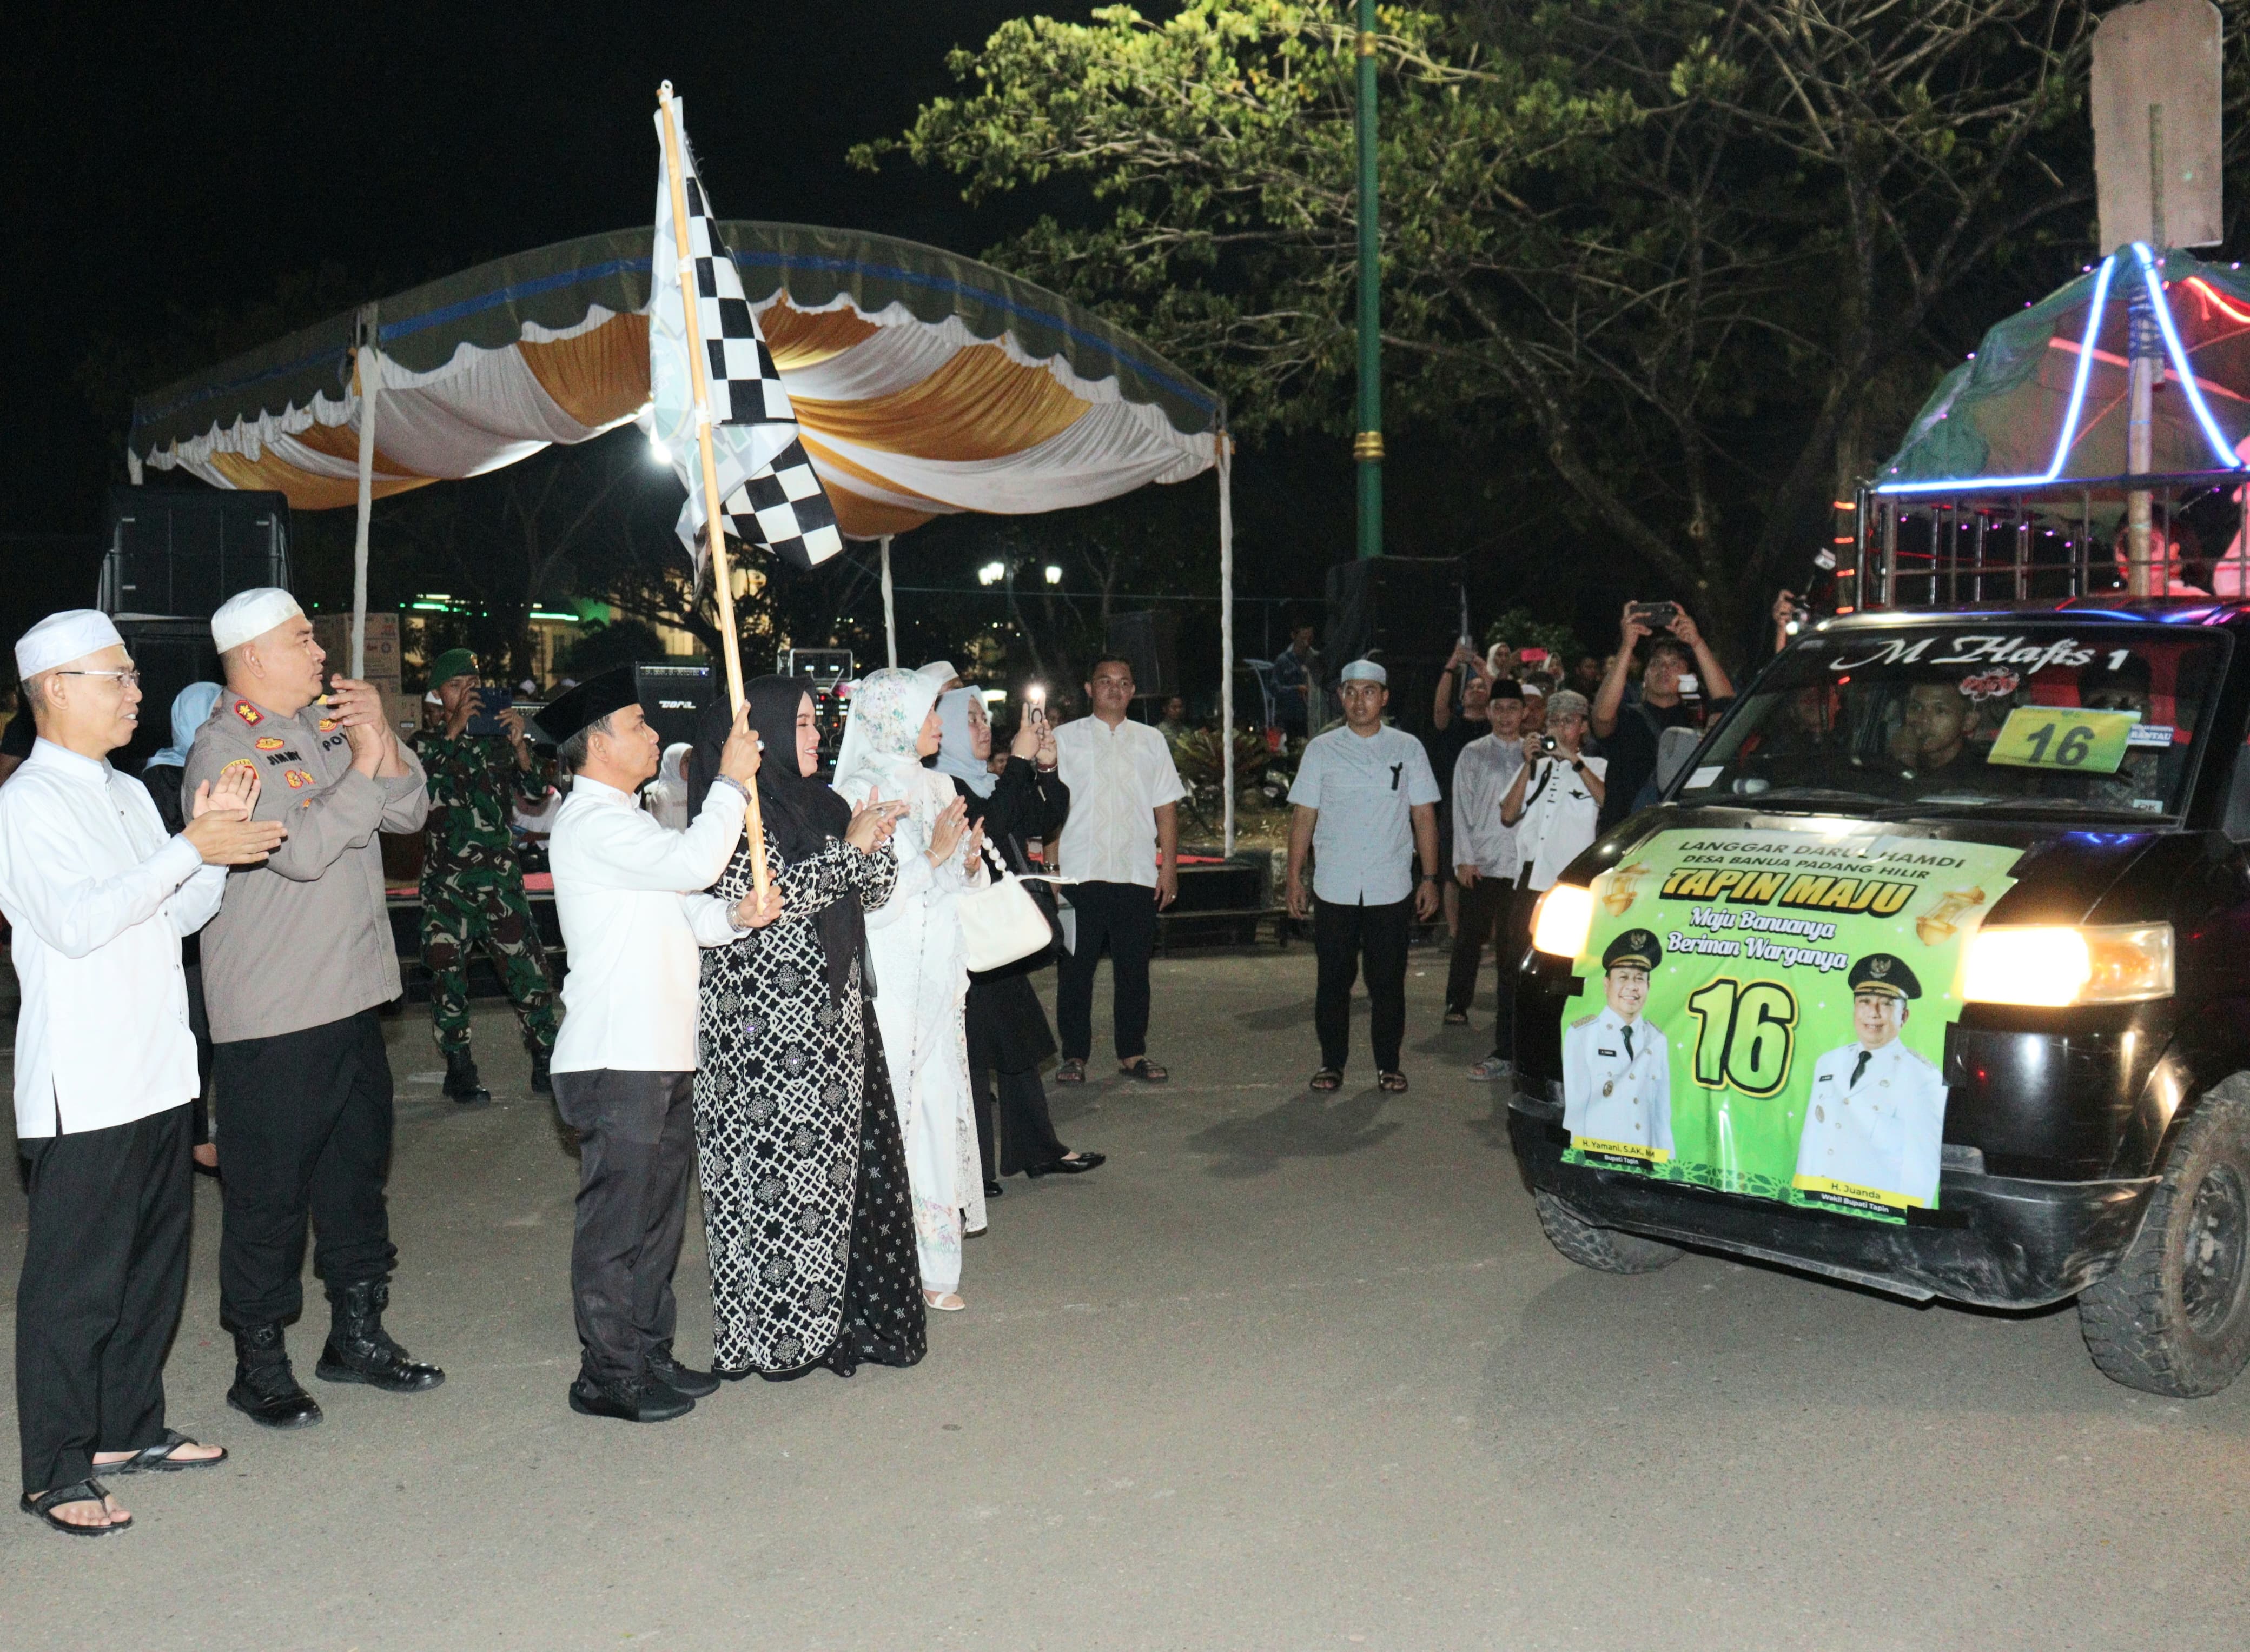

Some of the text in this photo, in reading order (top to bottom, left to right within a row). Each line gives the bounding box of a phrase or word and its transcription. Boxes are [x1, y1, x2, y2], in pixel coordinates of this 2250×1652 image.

[1829, 635, 2129, 675] M Hafis 1
[2027, 723, 2096, 766] 16
[1679, 841, 1789, 854] LANGGAR
[1880, 851, 1966, 868] HAMDI
[1682, 855, 1930, 879] DESA BANUA PADANG HILIR
[1659, 868, 1918, 917] TAPIN MAJU
[1689, 907, 1837, 940] Maju Banuanya
[1667, 932, 1849, 972] Beriman Warganya
[1686, 975, 1799, 1098] 16
[1592, 1142, 1622, 1153] Yamani,
[1604, 1155, 1623, 1163] Bupati
[1822, 1193, 1889, 1213] Wakil Bupati Tapin
[1831, 1183, 1881, 1199] H. Juanda
